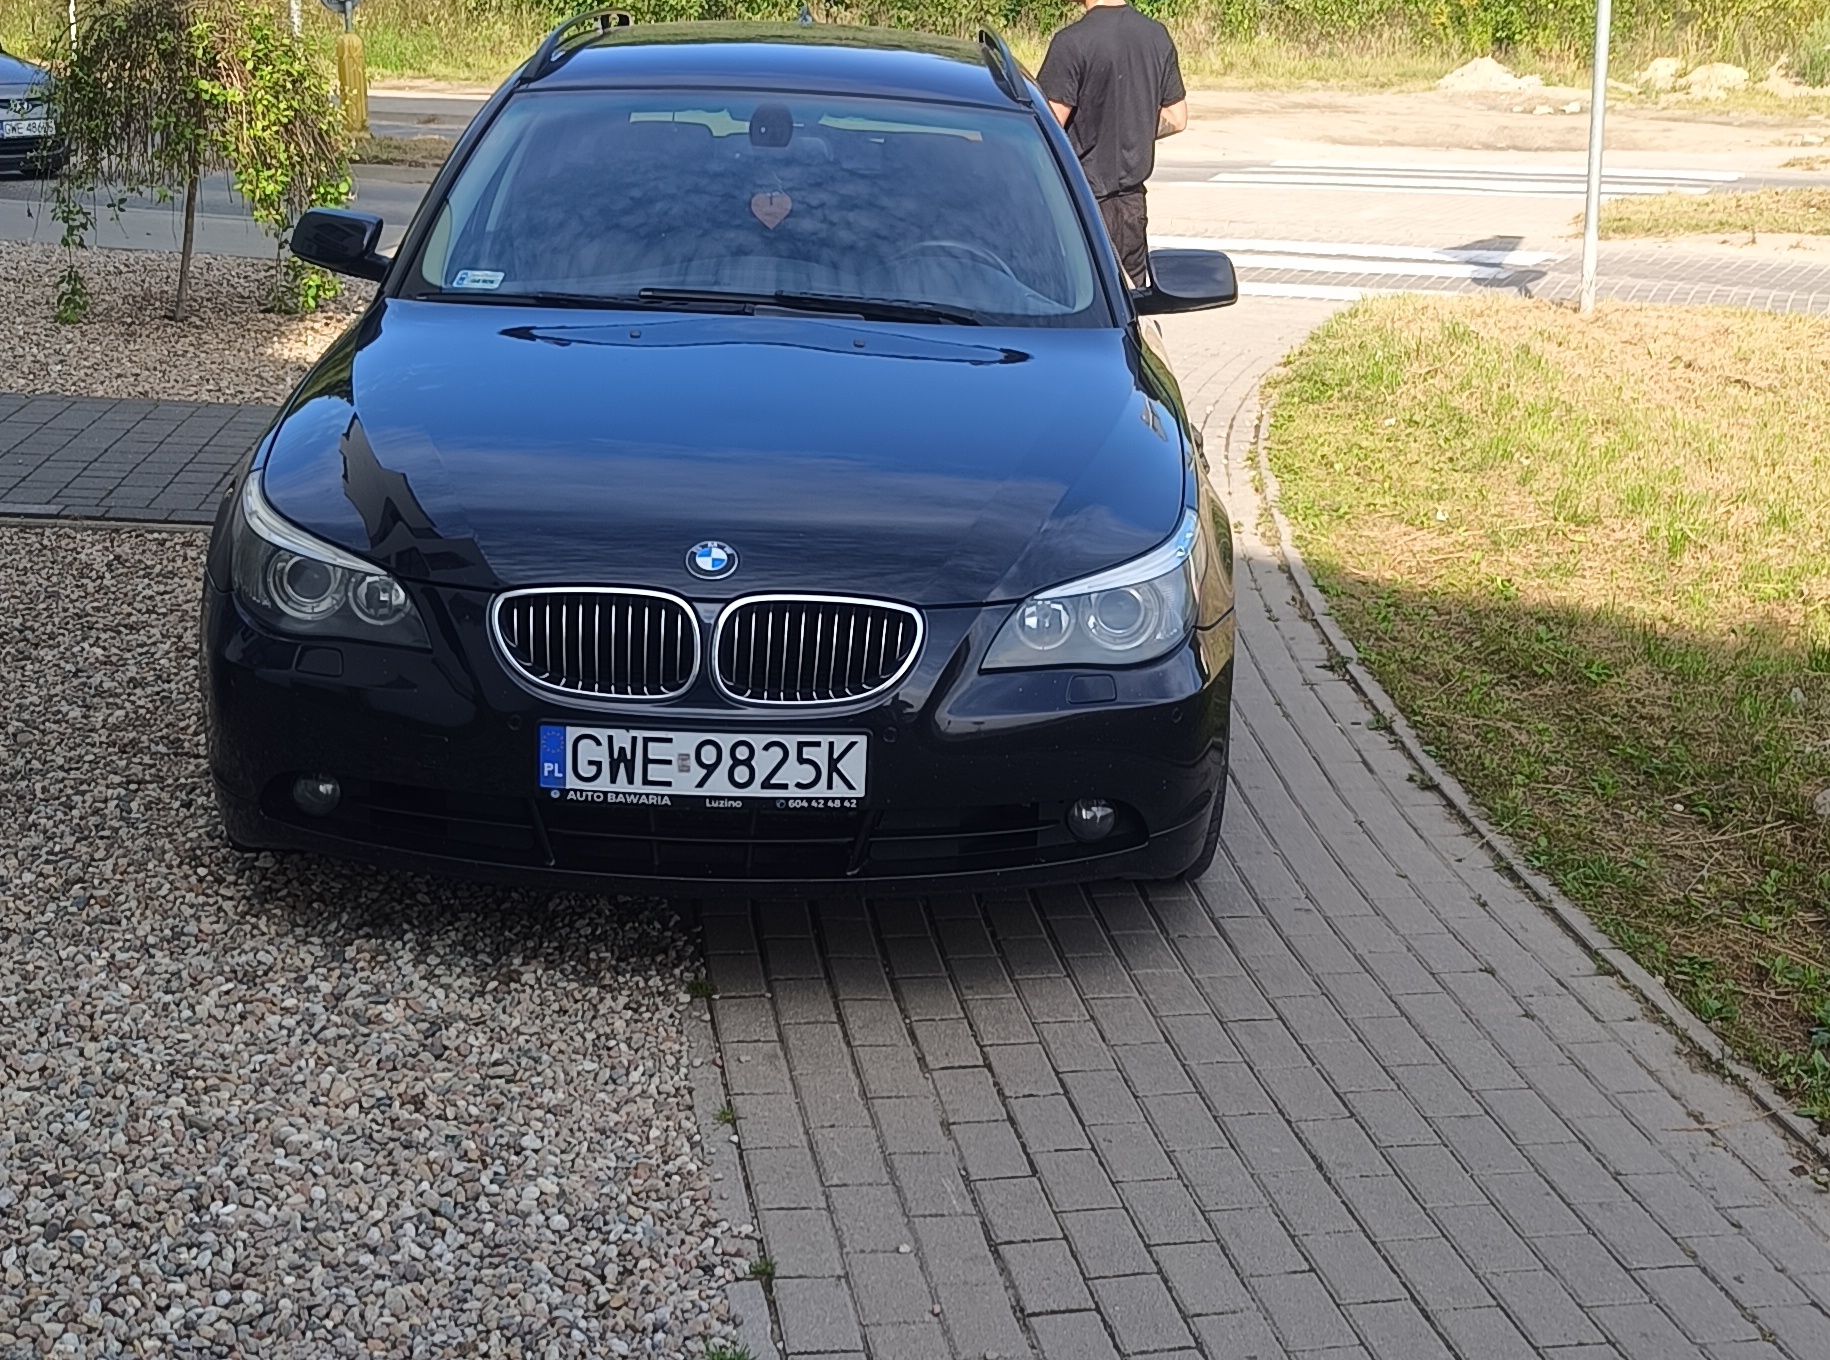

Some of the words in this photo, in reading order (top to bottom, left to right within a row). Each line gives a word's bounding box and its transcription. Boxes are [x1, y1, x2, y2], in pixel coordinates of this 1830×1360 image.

[5, 122, 23, 135] GWE
[571, 733, 674, 787] GWE
[694, 738, 859, 791] 9825K
[543, 763, 563, 777] PL
[567, 790, 604, 802] AUTO
[607, 792, 672, 805] BAWARIA
[706, 798, 742, 808] Luzino
[788, 799, 808, 808] 604
[811, 799, 824, 808] 42
[827, 799, 841, 808] 48
[843, 799, 857, 808] 42
